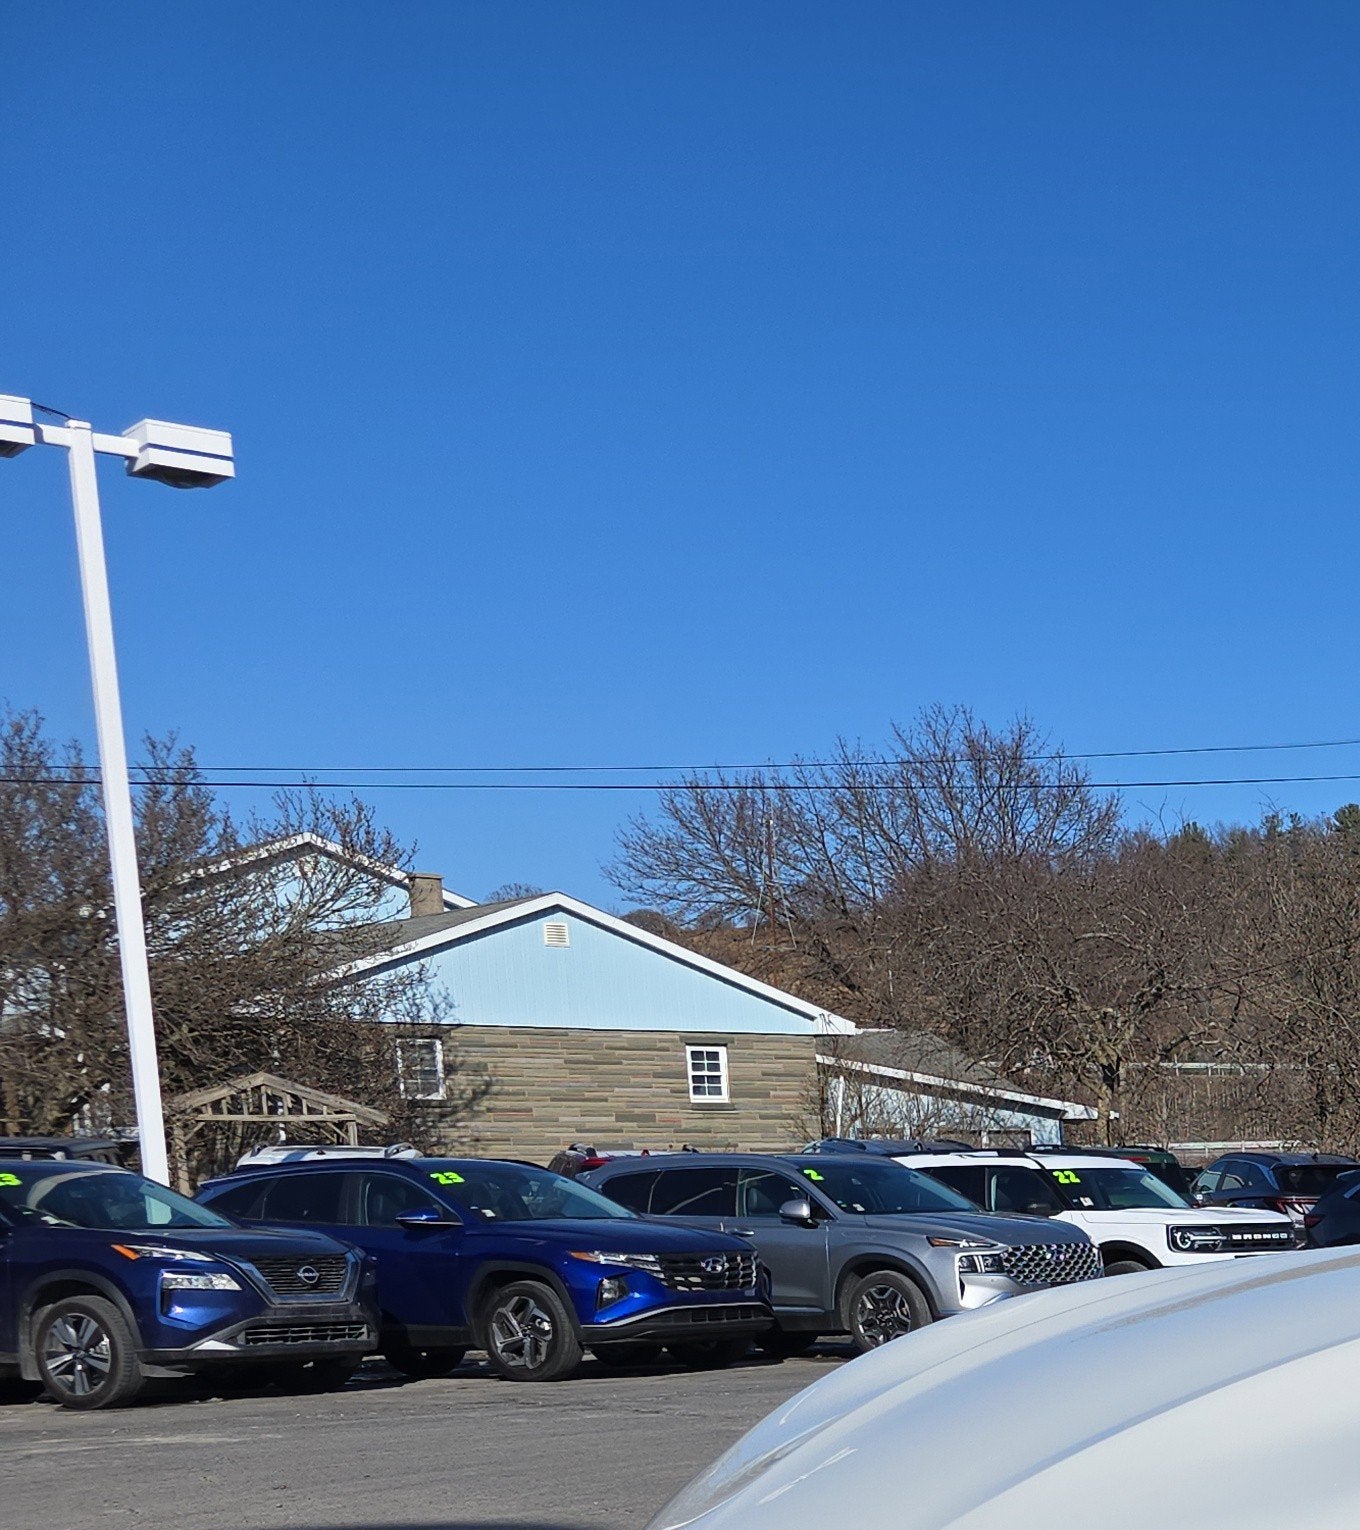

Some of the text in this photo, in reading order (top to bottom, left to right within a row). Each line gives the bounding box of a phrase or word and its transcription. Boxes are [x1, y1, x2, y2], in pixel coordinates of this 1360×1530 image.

[429, 1171, 466, 1185] 23
[803, 1169, 825, 1181] 2
[1052, 1170, 1081, 1184] 22
[1231, 1232, 1289, 1241] BRONCO
